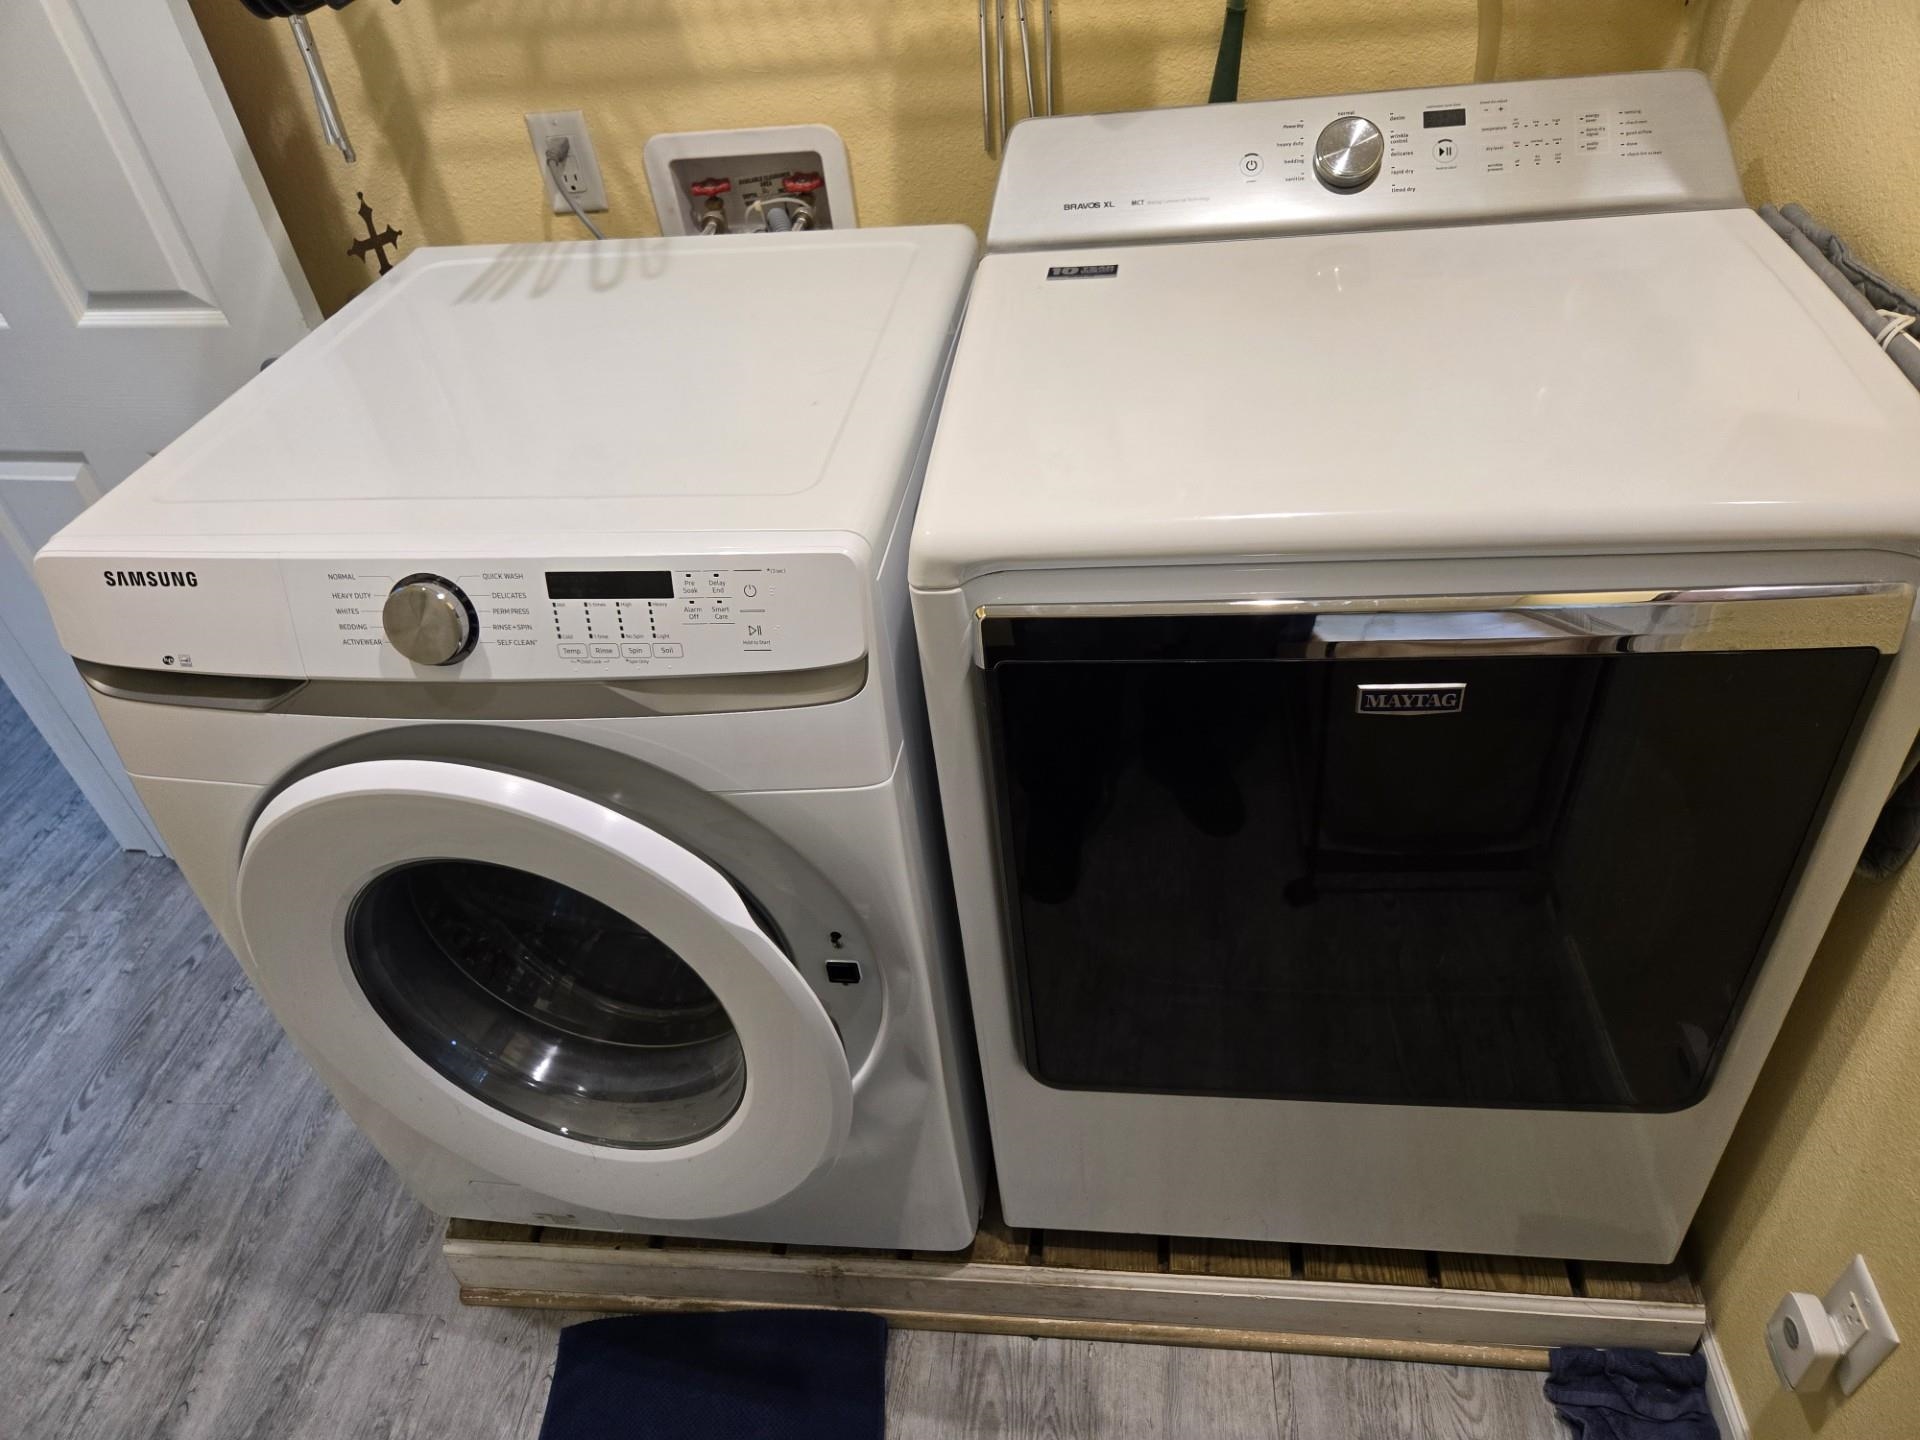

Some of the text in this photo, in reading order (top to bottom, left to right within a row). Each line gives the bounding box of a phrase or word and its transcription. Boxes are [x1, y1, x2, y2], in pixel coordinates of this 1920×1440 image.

[1064, 201, 1116, 211] BRAVOS XL
[103, 570, 198, 588] SAMSUNG
[342, 638, 383, 646] ACTIVEWEAR
[628, 647, 643, 655] Spin
[1365, 693, 1457, 708] MAYTAG
